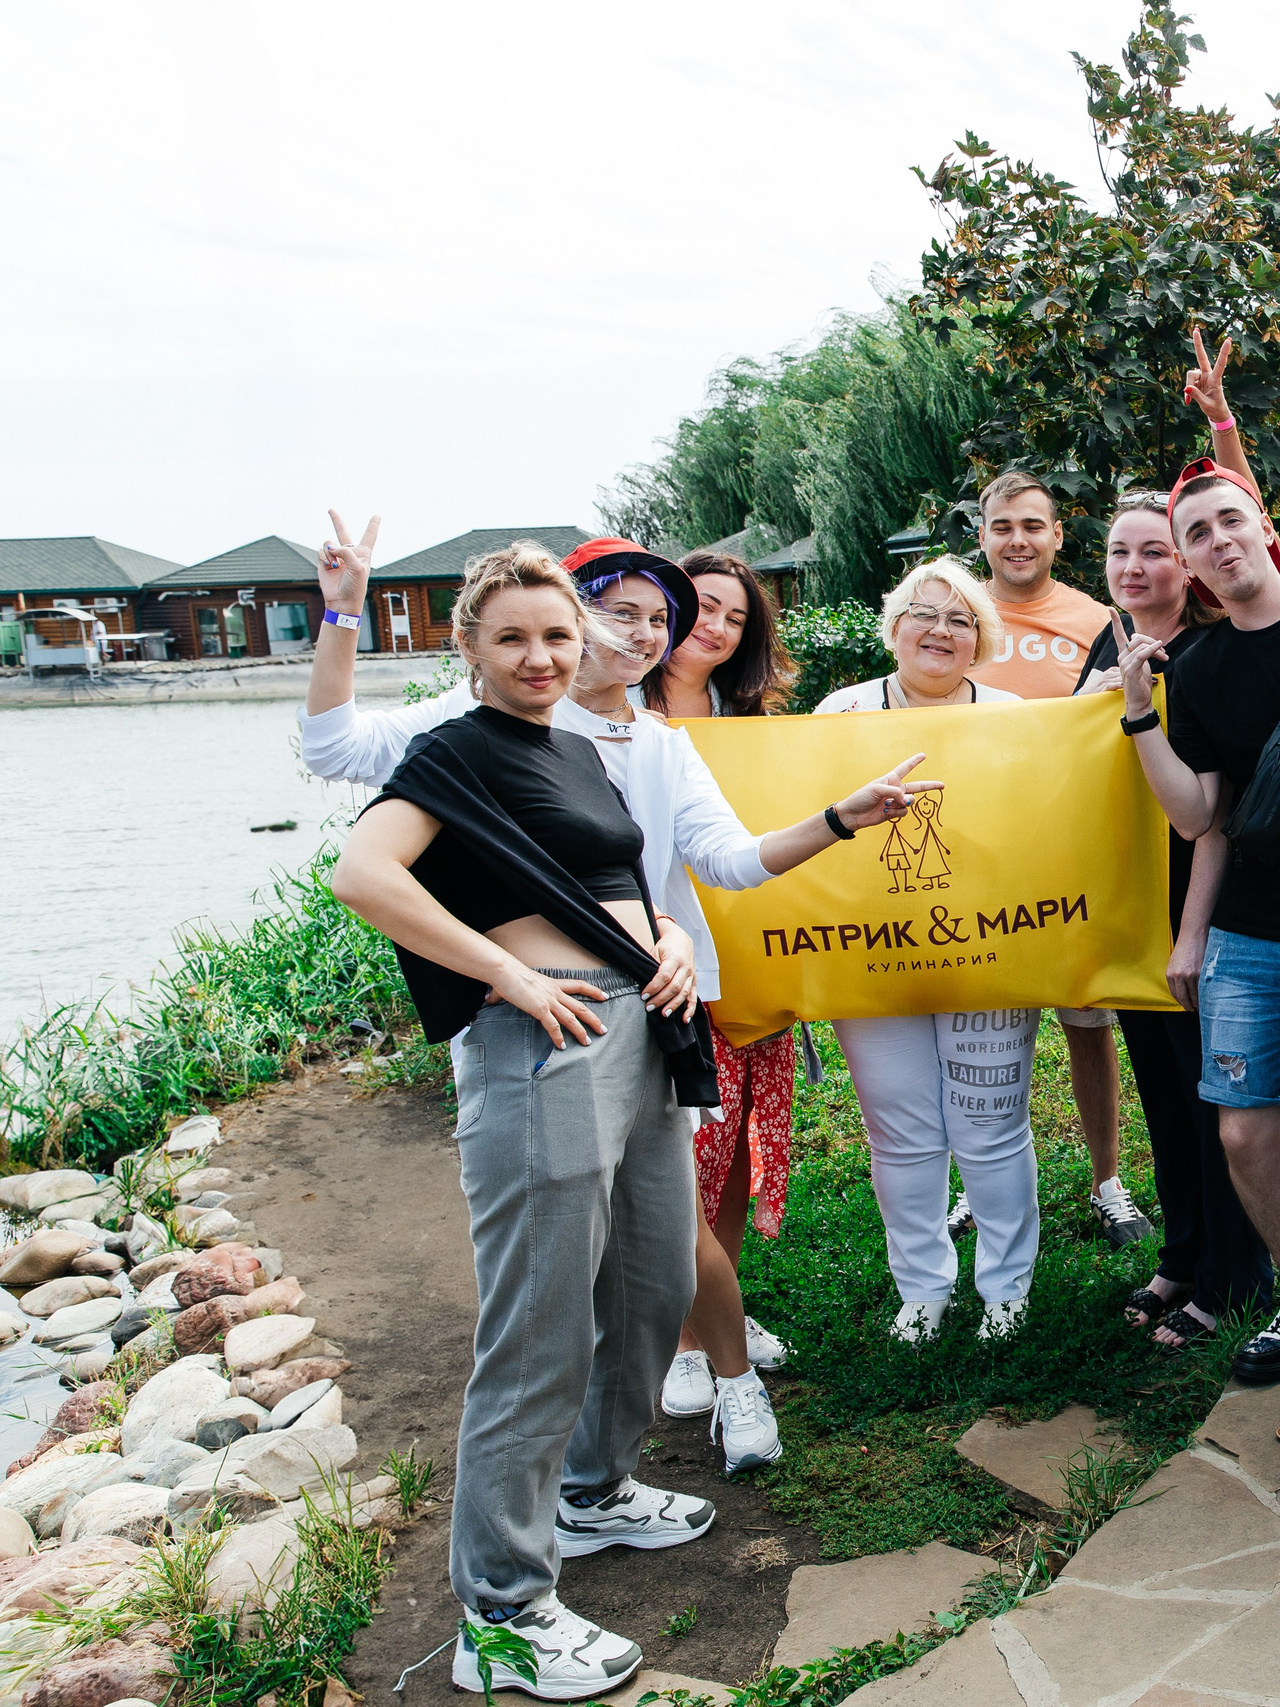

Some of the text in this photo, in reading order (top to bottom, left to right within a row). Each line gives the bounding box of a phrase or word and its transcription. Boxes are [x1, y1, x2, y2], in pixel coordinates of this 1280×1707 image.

[992, 633, 1079, 663] UGO
[762, 893, 1089, 957] ПАТРИК & МАРИ
[867, 951, 997, 974] КУЛИНАРИЯ
[951, 1063, 1018, 1086] FAILURE
[950, 1090, 986, 1112] EVER
